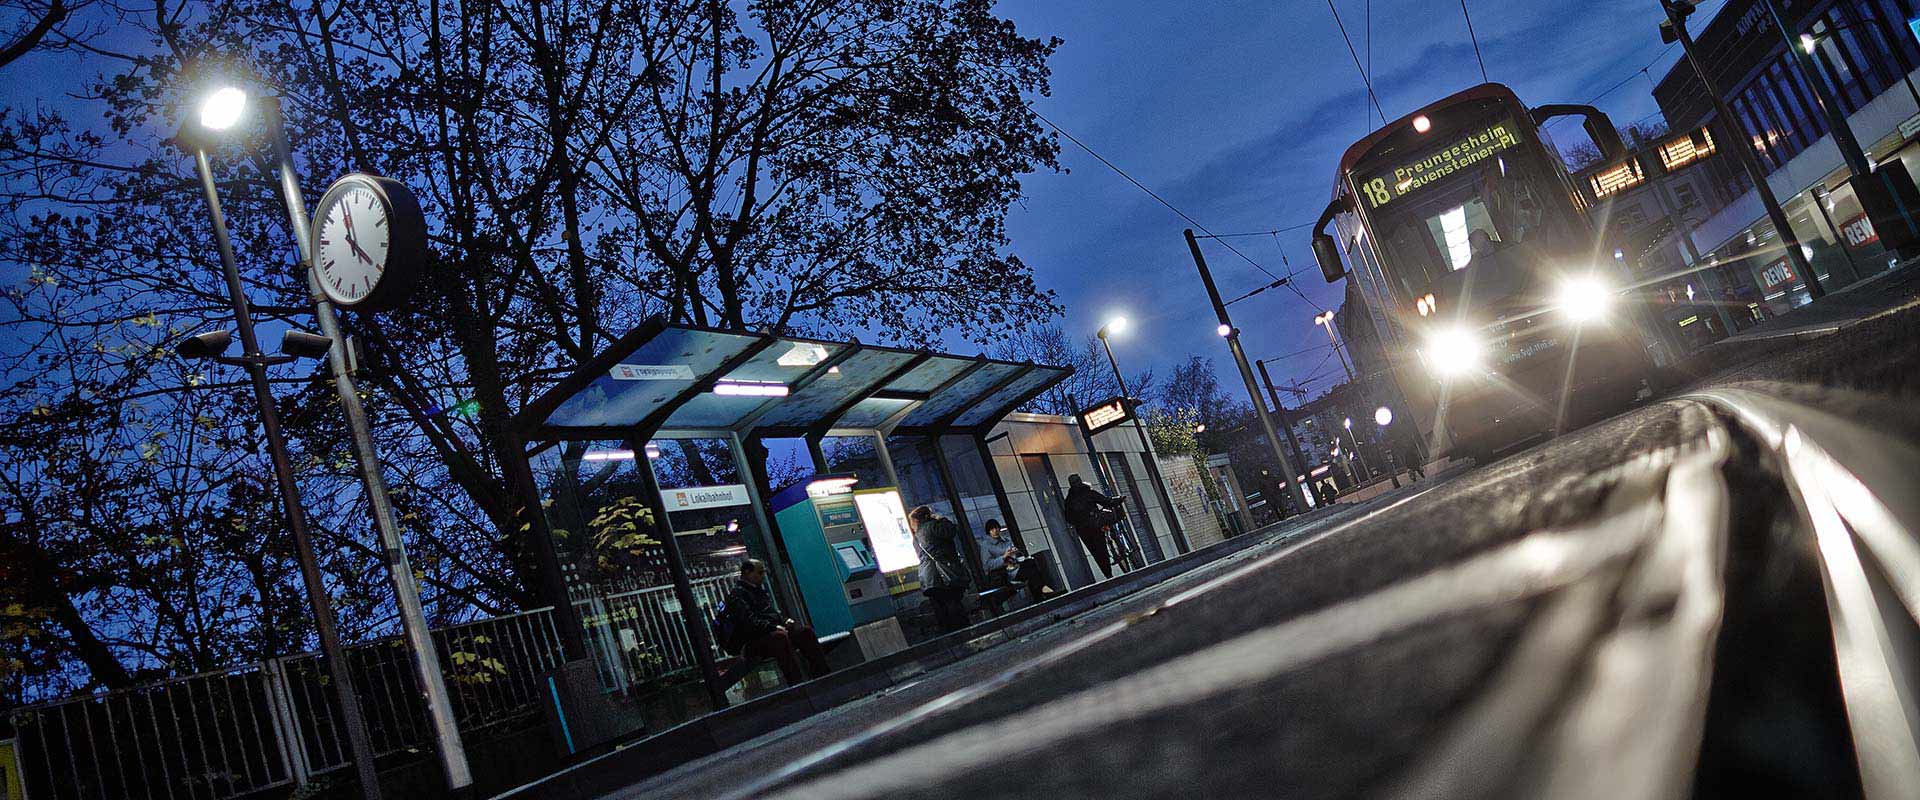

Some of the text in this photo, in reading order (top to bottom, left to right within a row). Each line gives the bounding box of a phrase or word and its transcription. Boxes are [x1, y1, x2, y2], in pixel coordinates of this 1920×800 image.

[1394, 126, 1506, 182] Preungesheim
[1362, 177, 1391, 209] 18
[1844, 216, 1876, 247] REW
[1762, 260, 1792, 288] REWE
[690, 490, 734, 504] Lokalbahnhof
